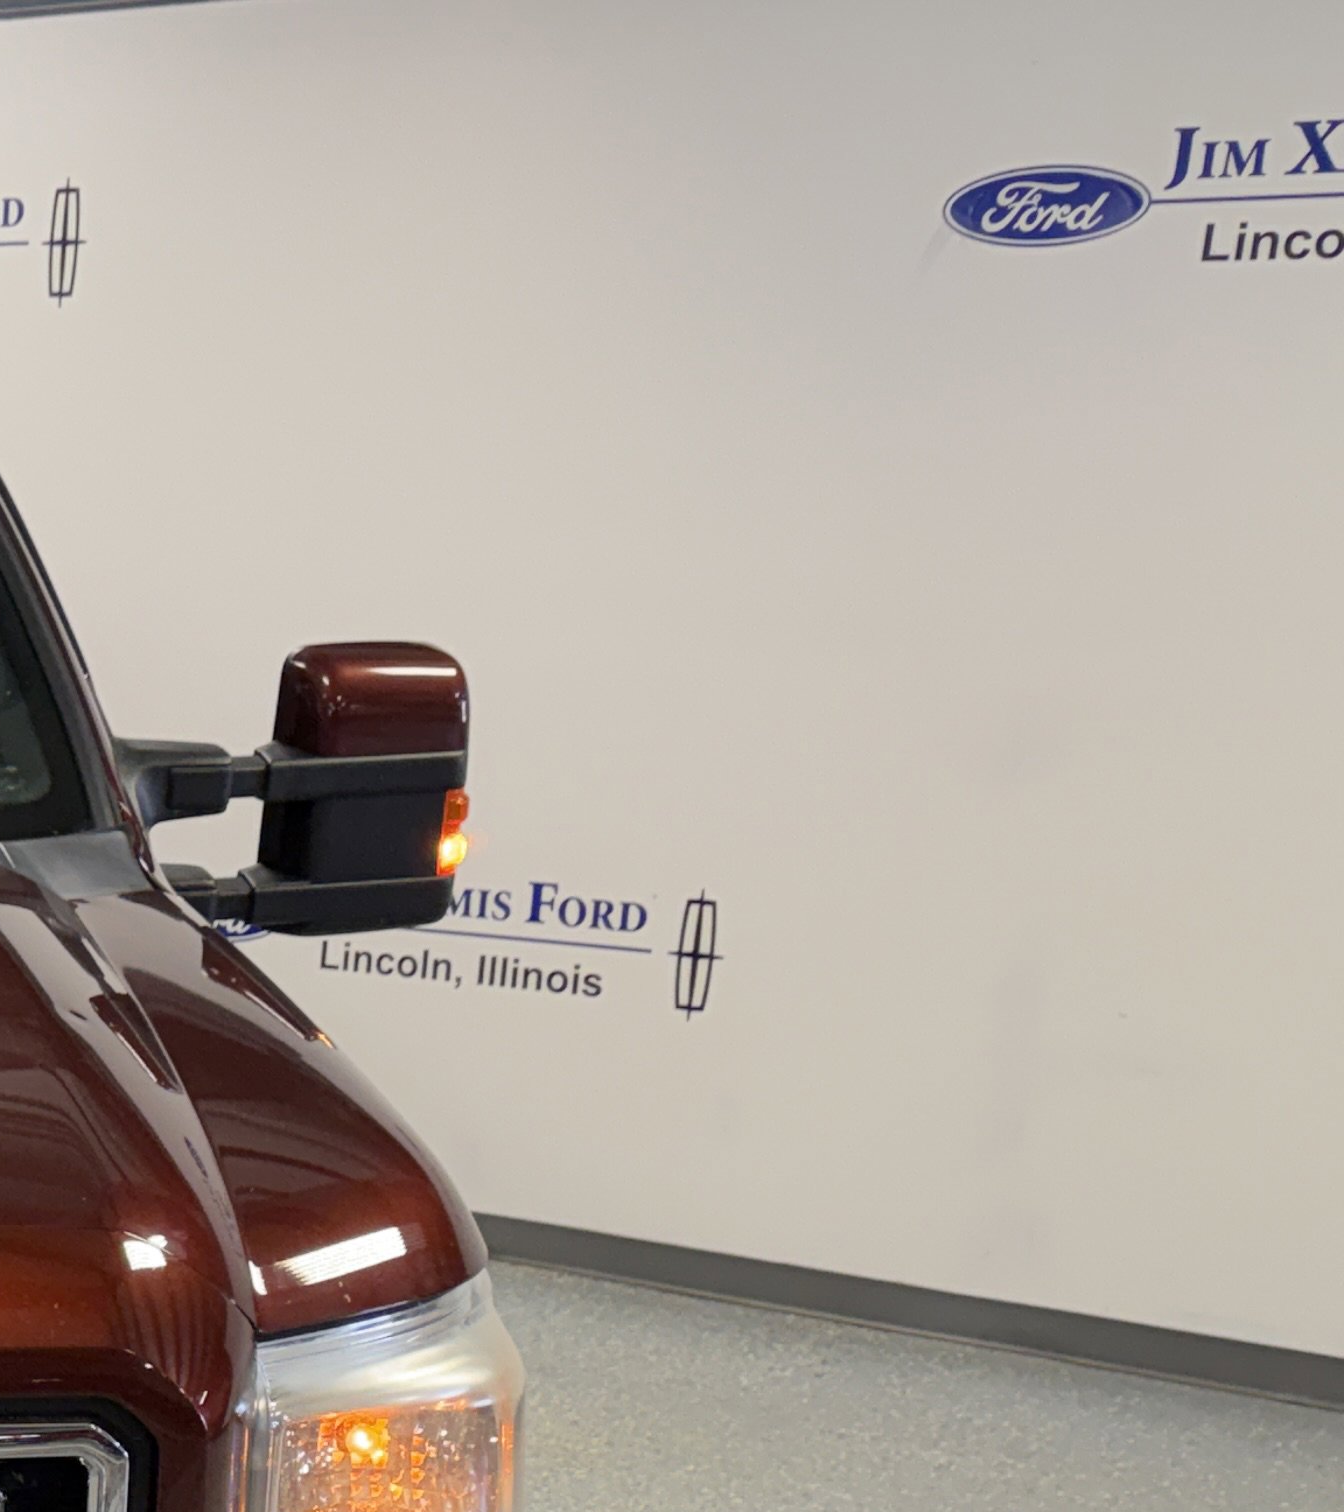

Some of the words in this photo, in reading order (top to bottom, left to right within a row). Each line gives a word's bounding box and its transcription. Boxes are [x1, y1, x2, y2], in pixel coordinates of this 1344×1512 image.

[1164, 126, 1271, 190] JIM
[981, 181, 1110, 233] Ford
[1201, 221, 1344, 262] Linco
[448, 887, 512, 921] MIS
[526, 882, 647, 932] FORD
[320, 940, 462, 989] Lincoln,
[477, 954, 604, 998] Illinois
